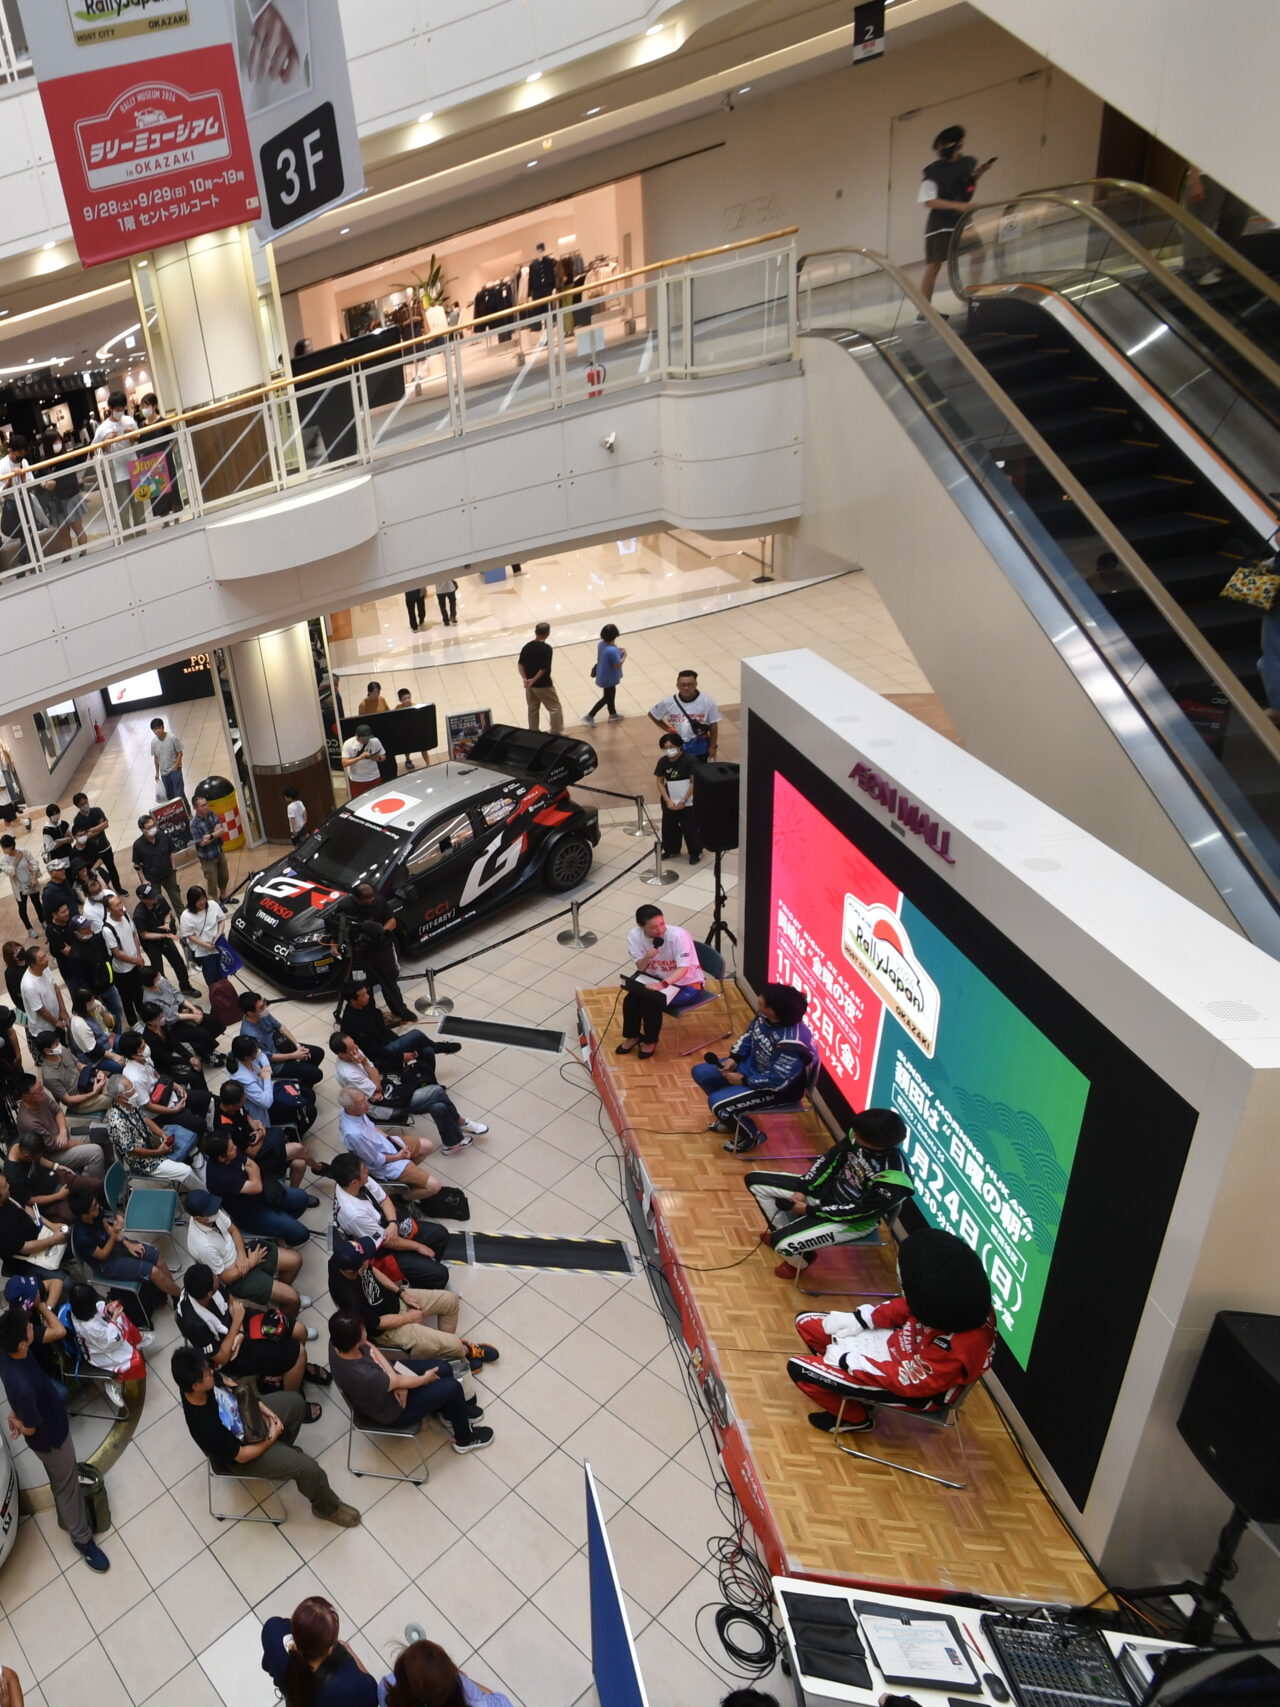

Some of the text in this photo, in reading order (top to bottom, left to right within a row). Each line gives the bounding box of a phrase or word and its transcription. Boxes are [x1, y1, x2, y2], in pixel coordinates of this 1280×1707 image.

[98, 28, 115, 39] CITY
[148, 14, 188, 30] OKAZAKI
[864, 25, 875, 41] 2
[89, 112, 220, 164] ラリーミュージアム
[135, 150, 196, 175] OKAZAKI
[276, 128, 325, 207] 3F
[117, 194, 220, 233] 1階 セントラルコート
[259, 897, 294, 919] DENSO
[425, 901, 450, 920] CCI
[235, 918, 247, 929] CCI
[274, 945, 290, 957] CCI
[778, 899, 865, 1010] FRIDAY NIGHT OKAZAKI
[895, 1006, 930, 1051] OKAZAKI
[897, 1049, 1034, 1233] SUNDAY MORNING NUKATA
[891, 1106, 1022, 1312] 1月24日(日)
[787, 1231, 836, 1253] Sammy
